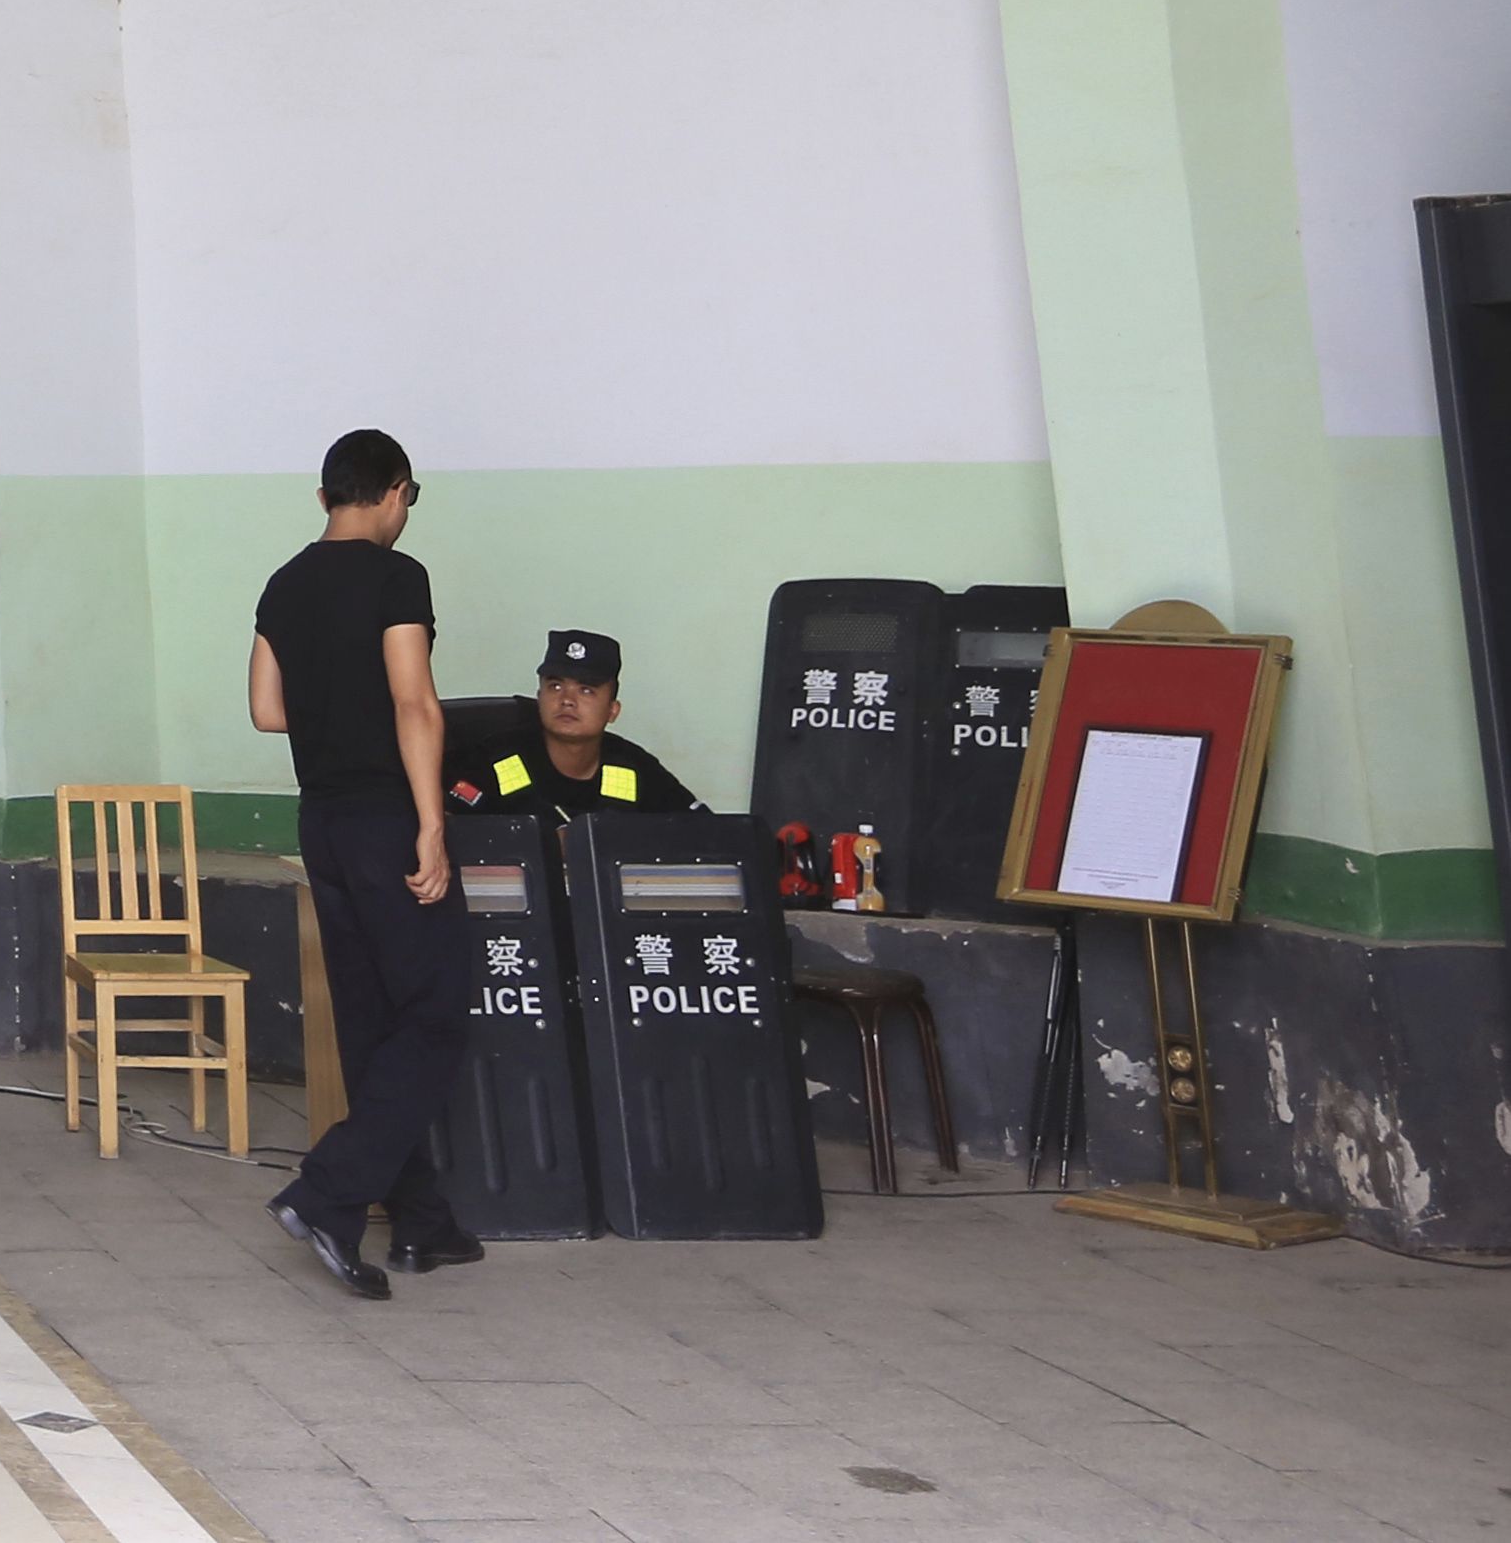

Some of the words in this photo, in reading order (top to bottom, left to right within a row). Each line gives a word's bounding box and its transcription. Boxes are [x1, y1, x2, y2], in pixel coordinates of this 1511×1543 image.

[803, 670, 889, 706] 警察
[791, 707, 895, 732] POLICE
[635, 935, 740, 976] 警察
[630, 985, 760, 1015] POLICE
